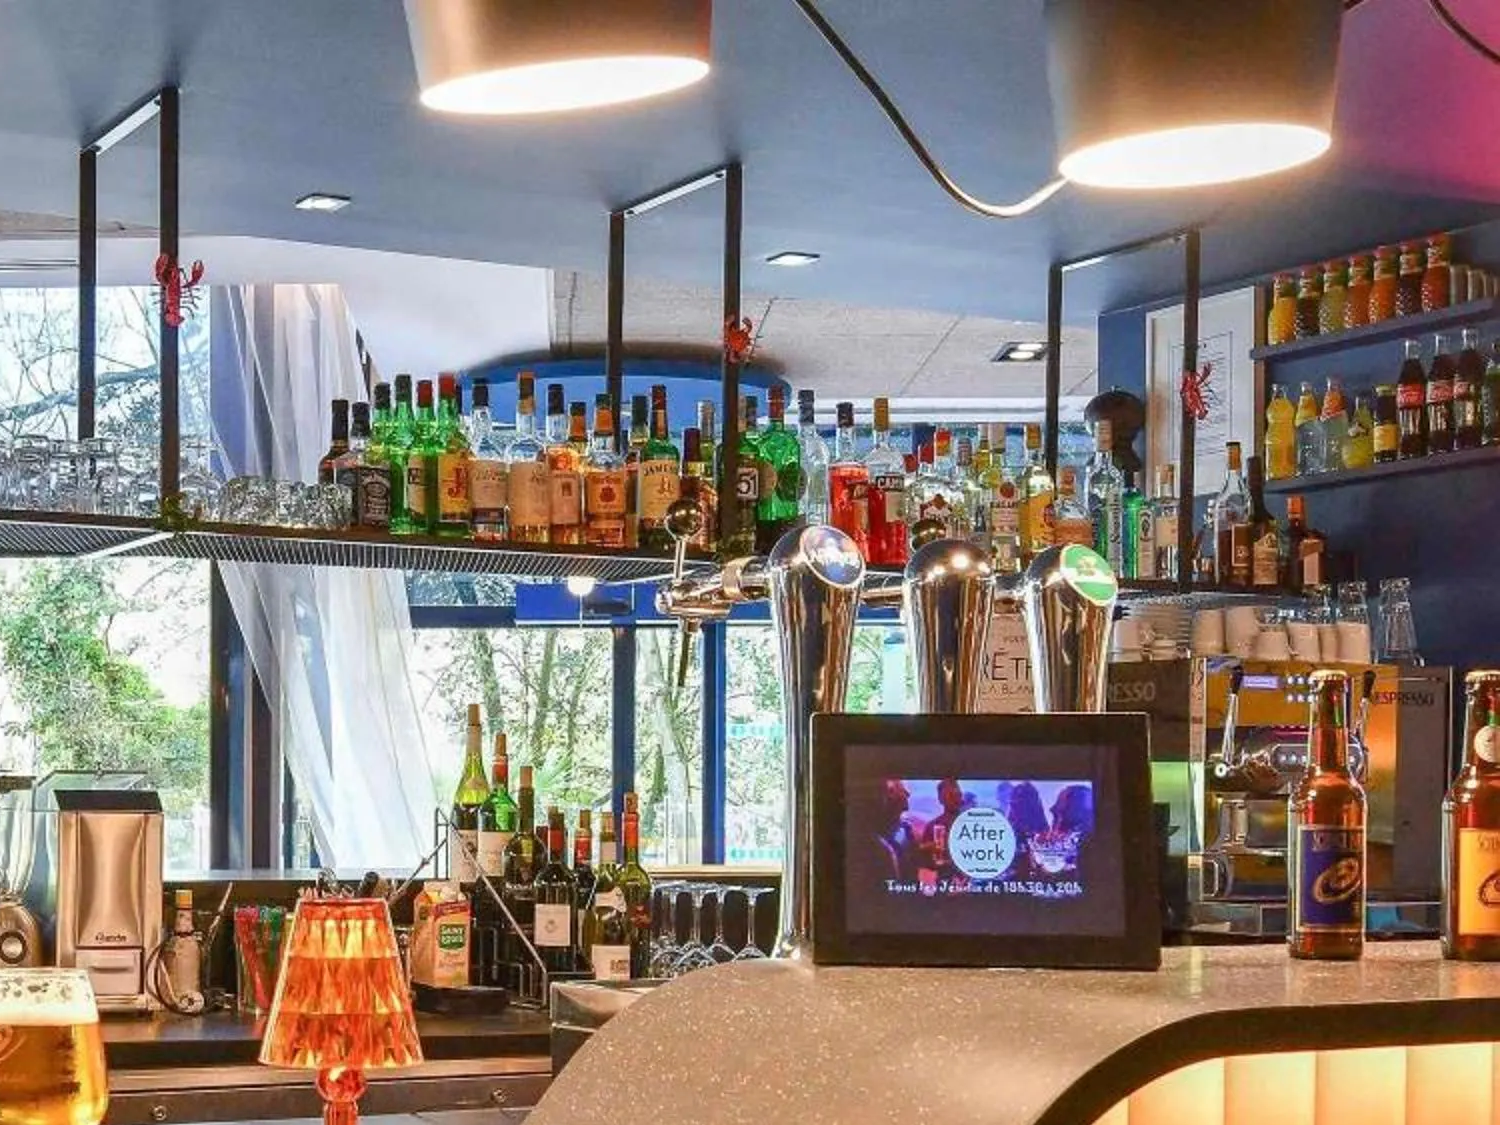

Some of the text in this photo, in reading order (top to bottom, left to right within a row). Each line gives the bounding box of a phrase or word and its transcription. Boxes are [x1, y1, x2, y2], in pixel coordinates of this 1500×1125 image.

[957, 823, 1006, 841] After
[960, 843, 1005, 861] work
[885, 879, 917, 893] Tous
